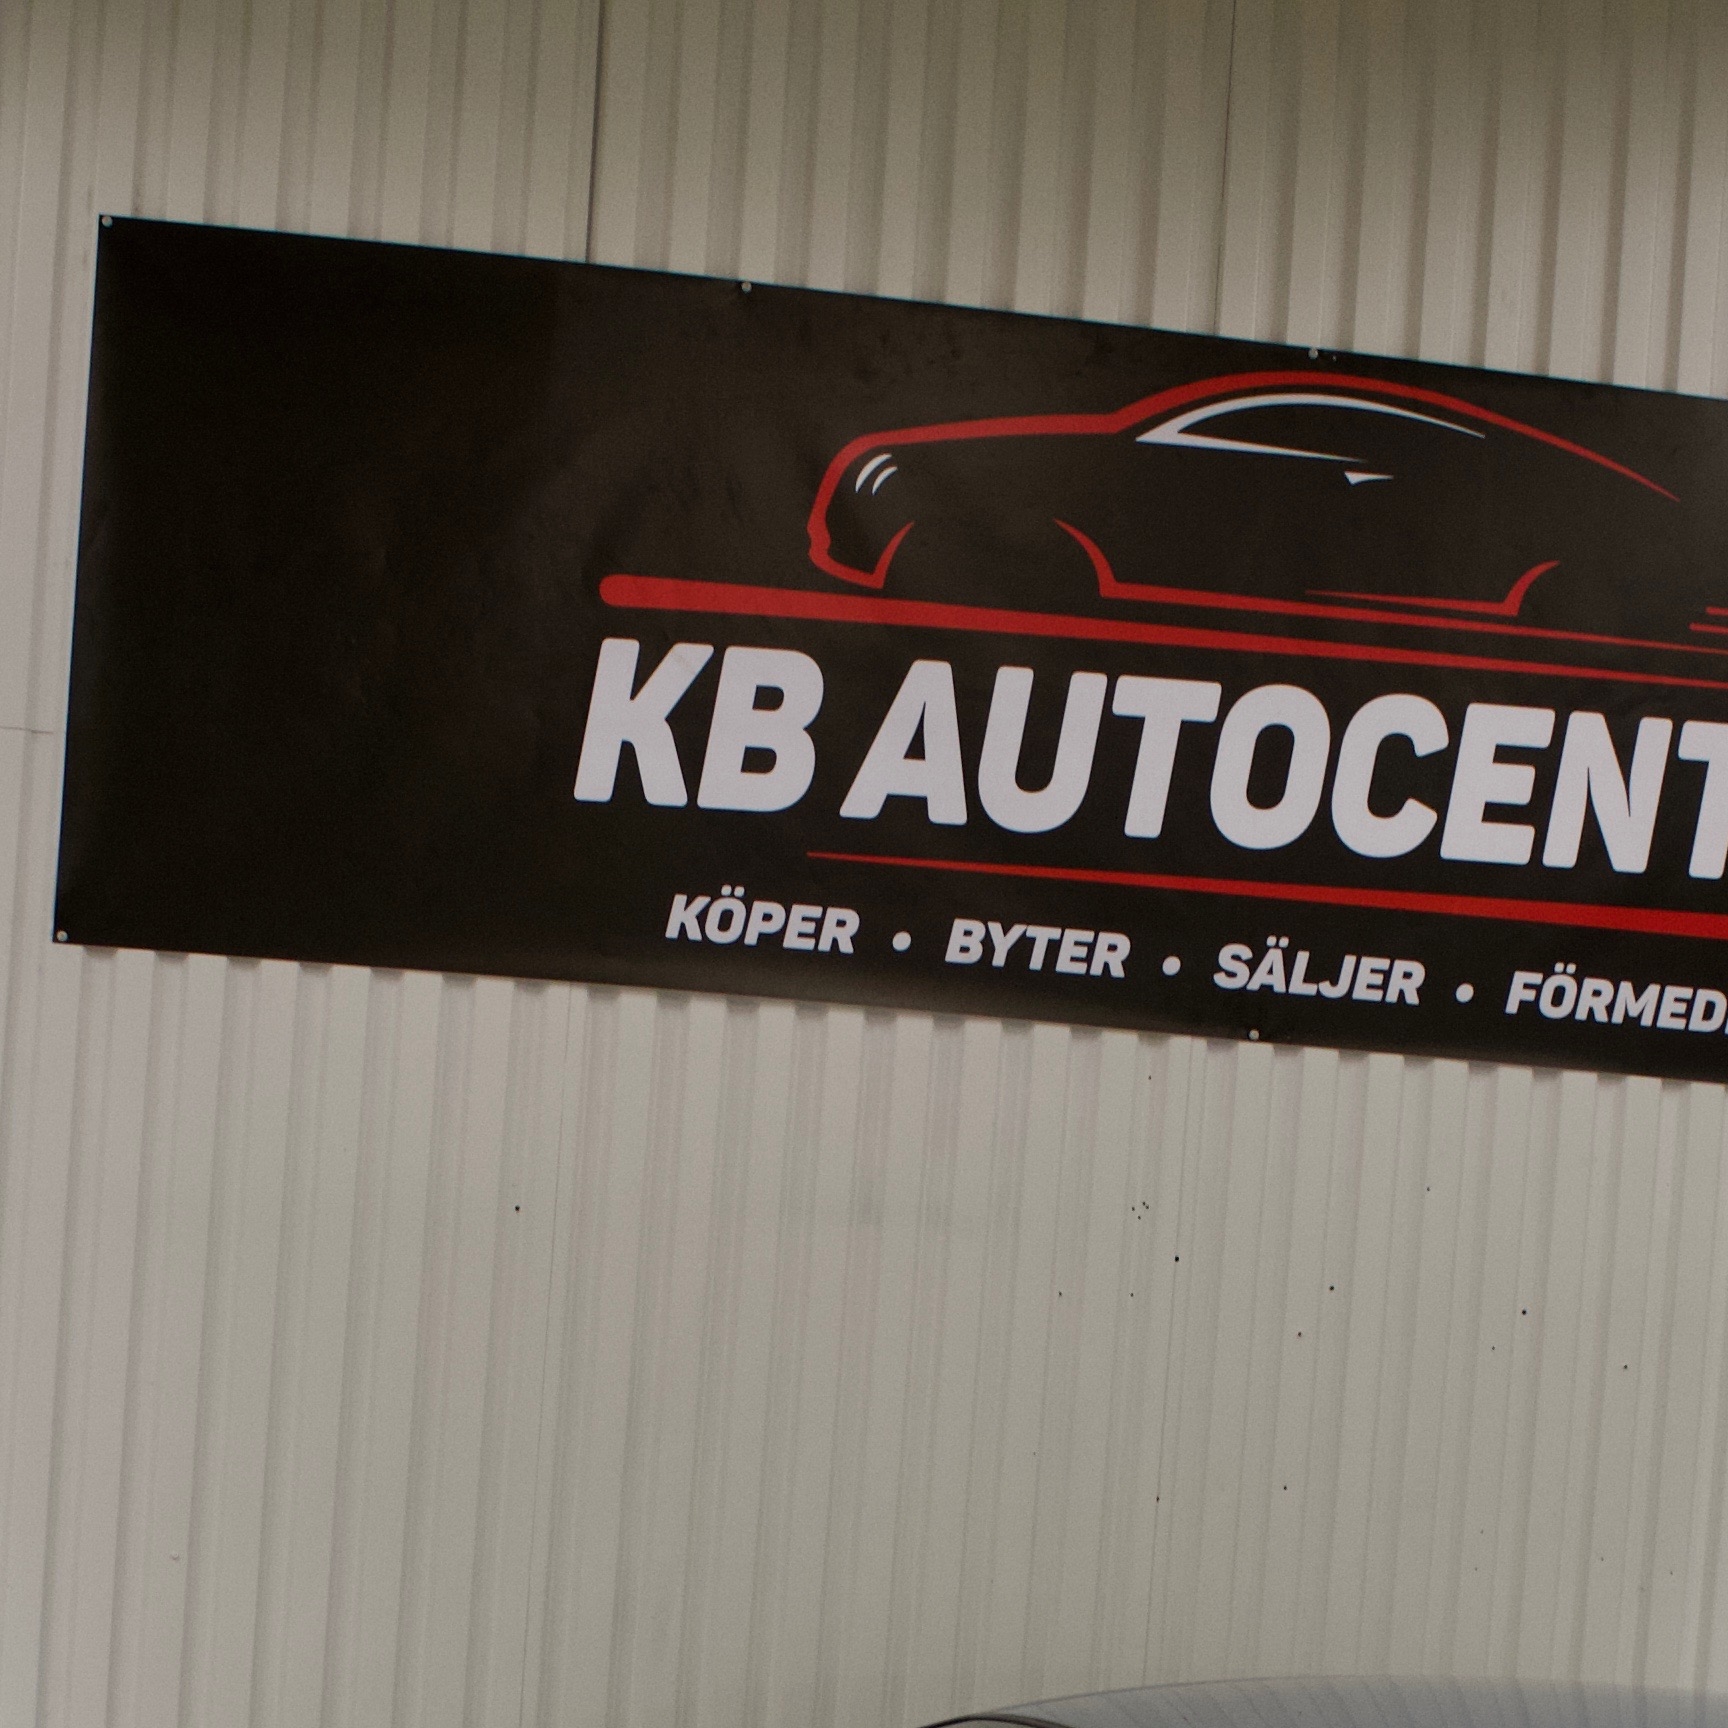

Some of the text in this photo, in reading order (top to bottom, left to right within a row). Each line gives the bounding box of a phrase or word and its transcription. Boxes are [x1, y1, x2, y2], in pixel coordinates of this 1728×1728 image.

[572, 637, 825, 813] KB
[664, 884, 861, 955] KÖPER
[943, 917, 1132, 979] BYTER
[1212, 935, 1427, 1006] SÄLJER
